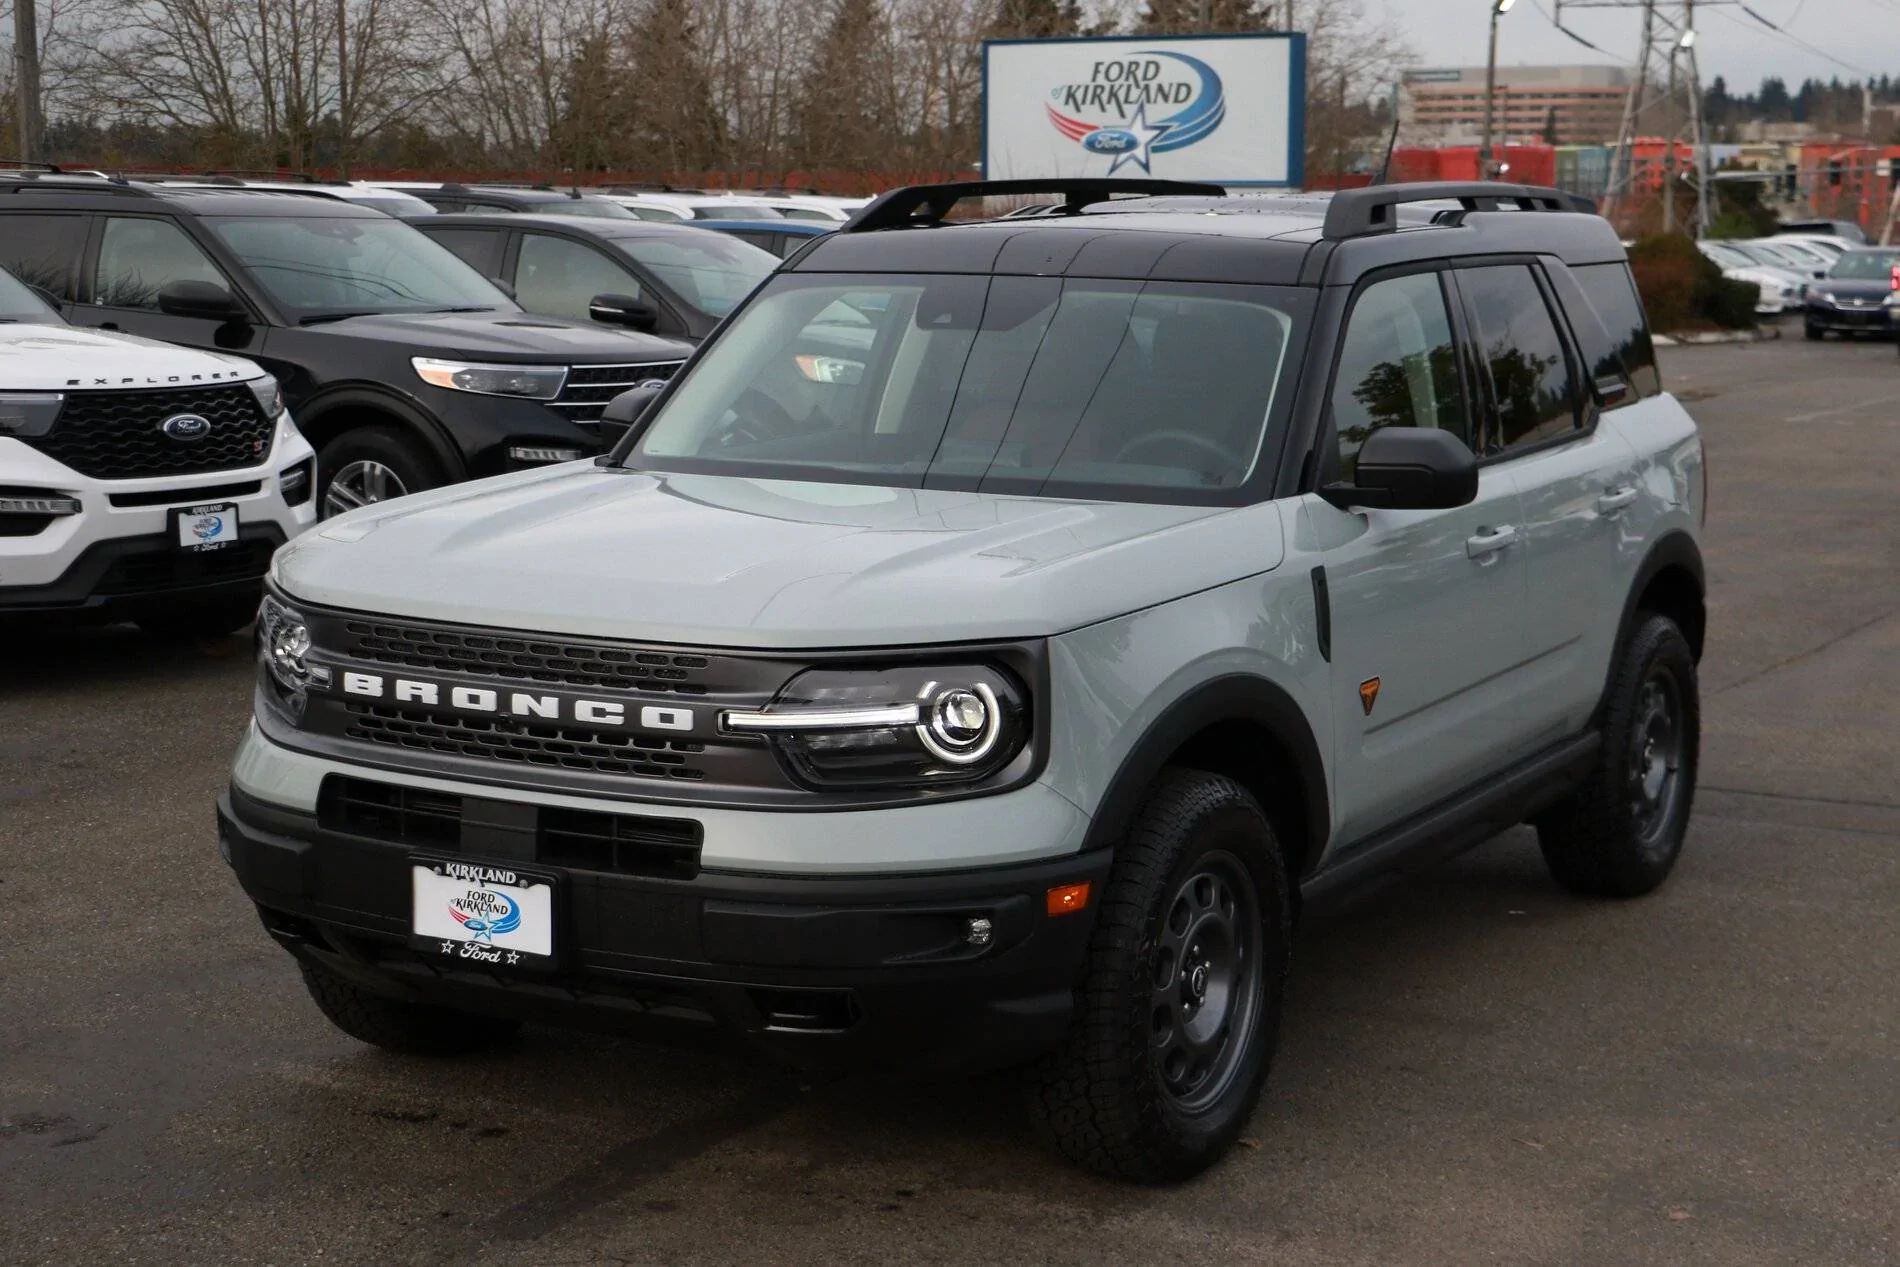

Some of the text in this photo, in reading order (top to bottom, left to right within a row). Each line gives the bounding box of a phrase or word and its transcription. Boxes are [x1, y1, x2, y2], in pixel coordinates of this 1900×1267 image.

[1091, 60, 1160, 90] FORD
[1063, 82, 1193, 119] KIRKLAND
[66, 371, 240, 386] EXPLORER
[344, 672, 694, 732] BRONCO
[446, 863, 517, 887] KIRKLAND
[456, 898, 508, 917] KIRKLAND
[467, 891, 495, 905] FORD
[460, 942, 502, 963] Ford
